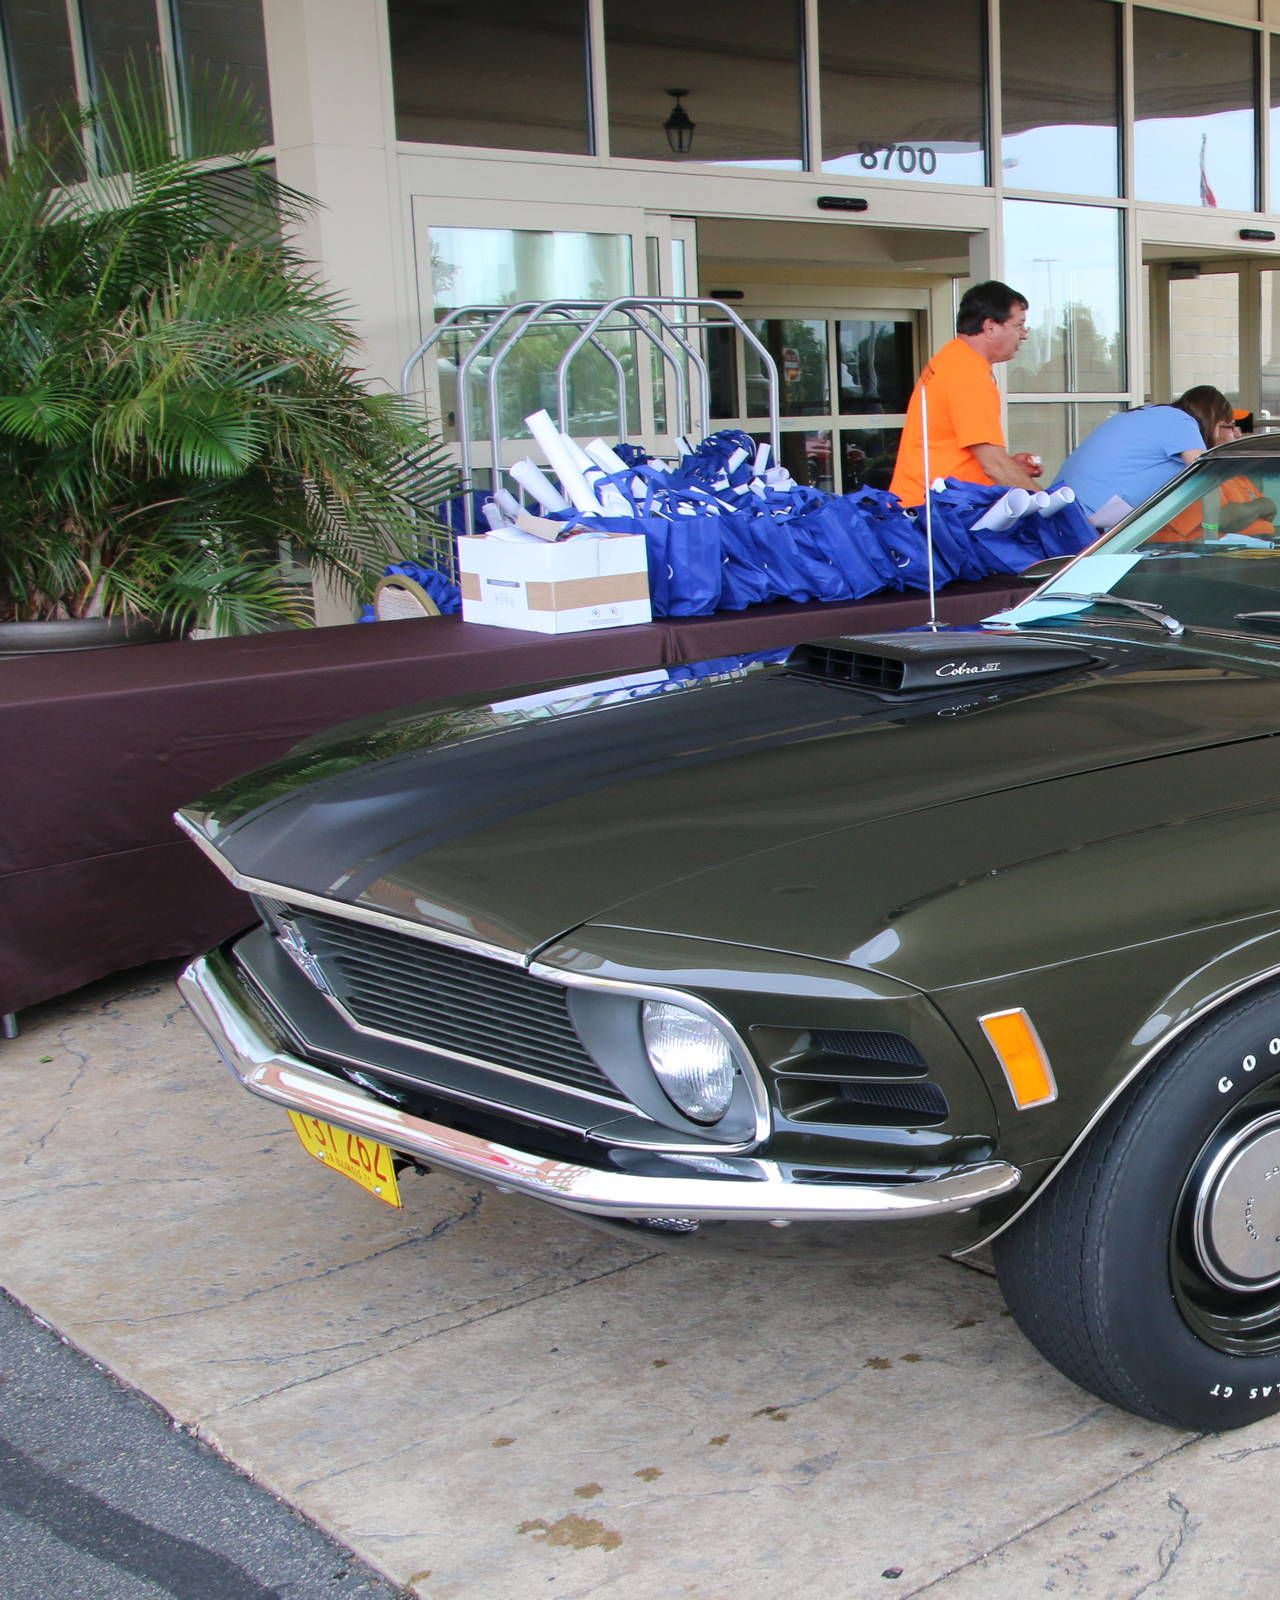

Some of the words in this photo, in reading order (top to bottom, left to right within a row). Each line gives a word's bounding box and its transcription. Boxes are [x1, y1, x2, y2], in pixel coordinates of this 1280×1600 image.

[859, 142, 937, 175] 8700
[936, 662, 979, 677] Cobra
[1209, 1383, 1233, 1398] GT
